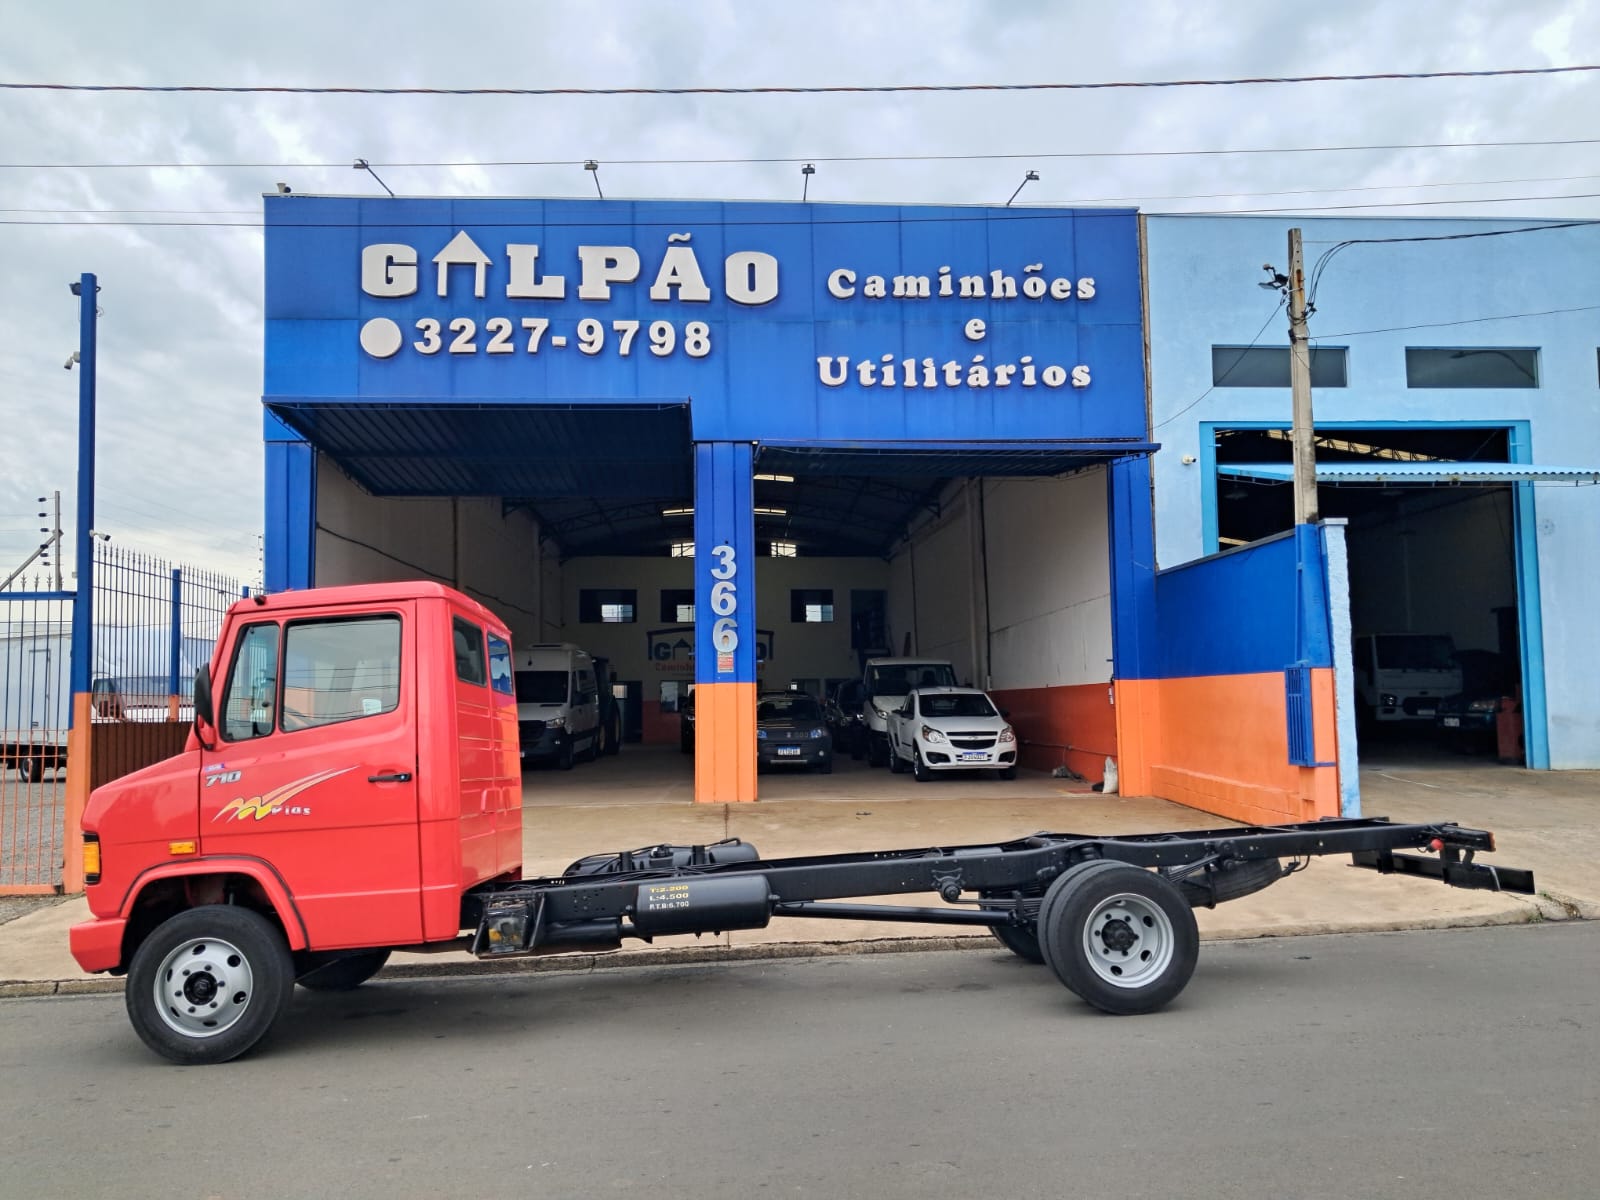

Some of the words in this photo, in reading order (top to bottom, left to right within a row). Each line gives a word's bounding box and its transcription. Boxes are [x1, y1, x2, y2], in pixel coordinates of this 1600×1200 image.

[827, 263, 1096, 299] Caminhões
[414, 317, 712, 357] 3227-9798
[964, 318, 987, 341] e
[817, 353, 1091, 388] Utilitários
[710, 545, 739, 653] 366
[205, 770, 242, 788] 710
[649, 892, 689, 901] L:4.500
